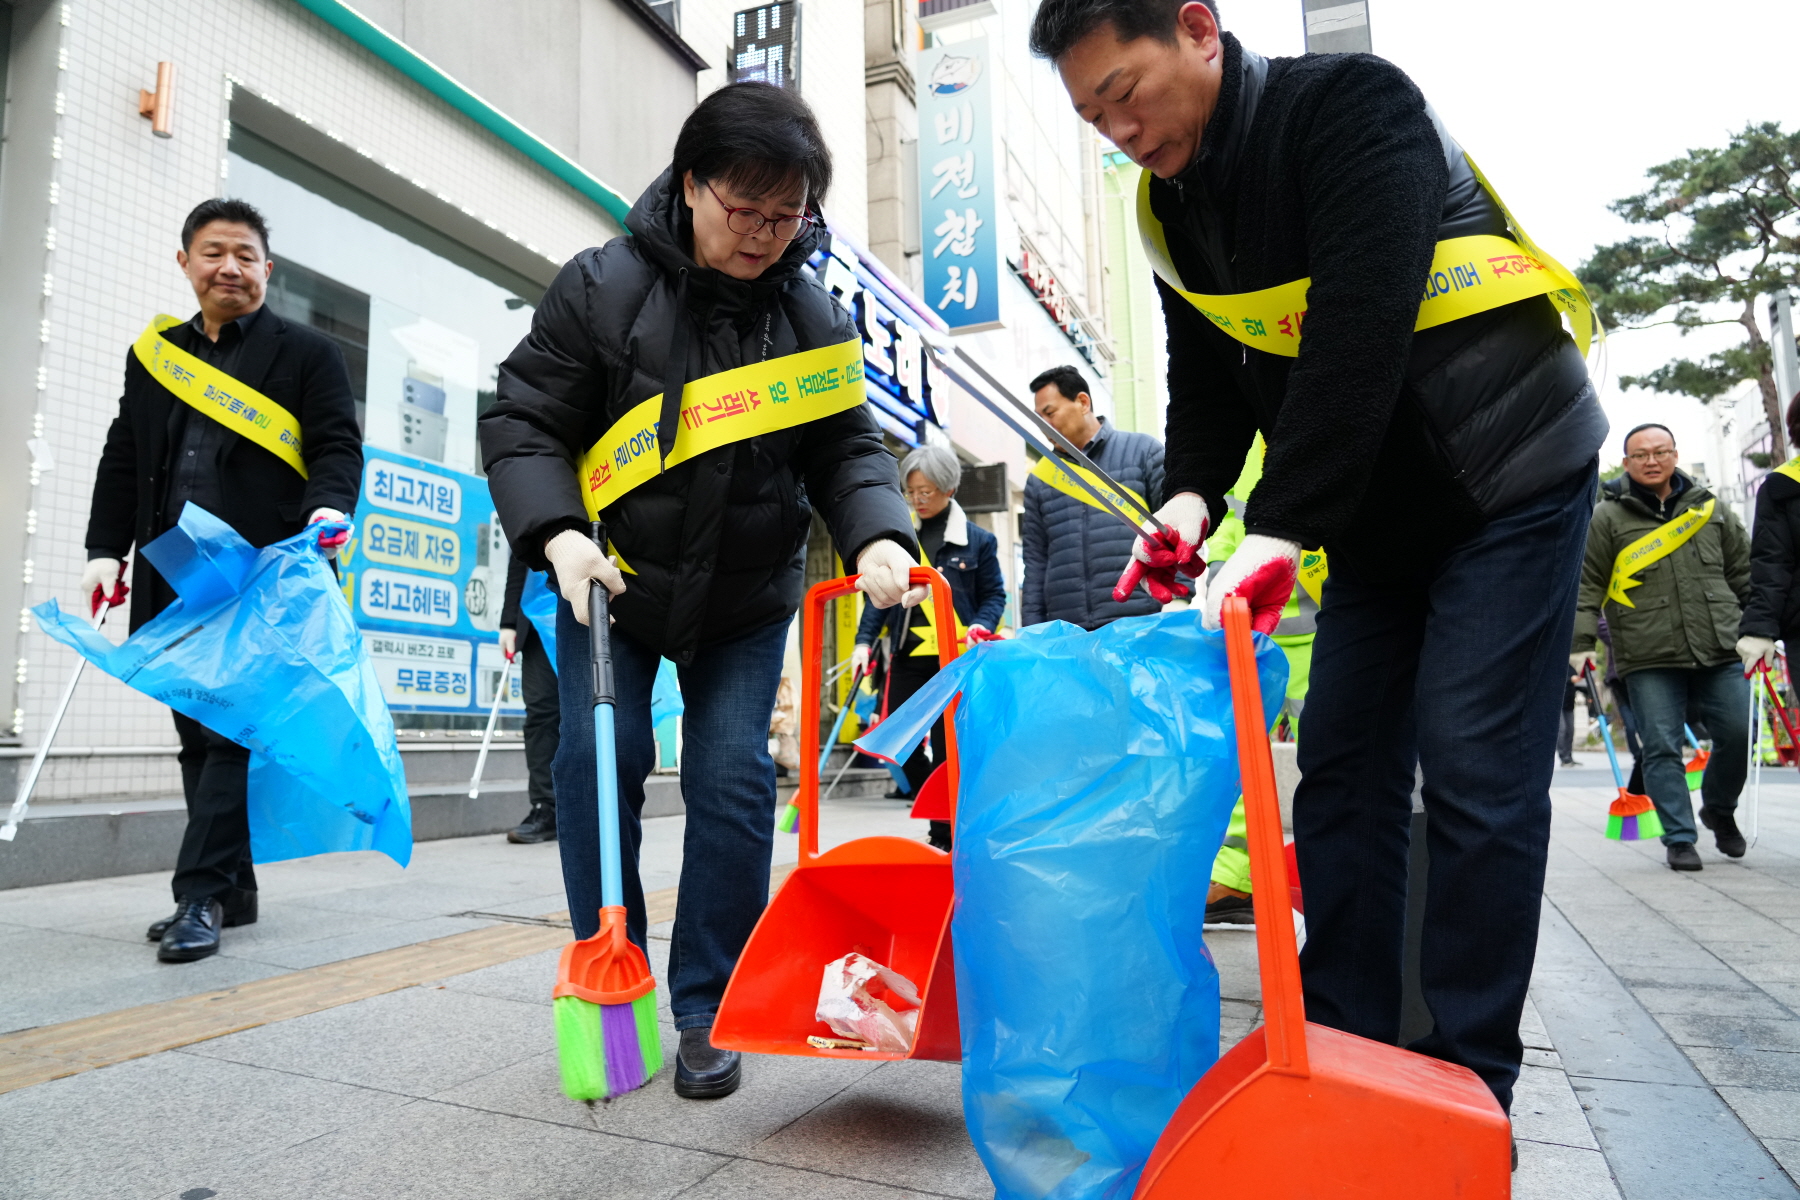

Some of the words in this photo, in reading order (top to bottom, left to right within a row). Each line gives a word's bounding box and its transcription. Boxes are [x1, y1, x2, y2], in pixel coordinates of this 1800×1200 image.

[1241, 317, 1267, 337] 앞
[163, 359, 196, 387] 쓰레기
[203, 384, 272, 429] 분리배출은
[681, 388, 762, 431] 쓰레기는
[767, 381, 790, 404] 앞
[373, 469, 454, 516] 최고지원
[369, 523, 420, 560] 요금제
[424, 533, 455, 567] 자유
[369, 579, 451, 619] 최고혜택
[372, 639, 405, 655] 갤럭시
[408, 642, 434, 657] 버즈2
[437, 646, 455, 659] 프로
[397, 668, 467, 695] 무료증정
